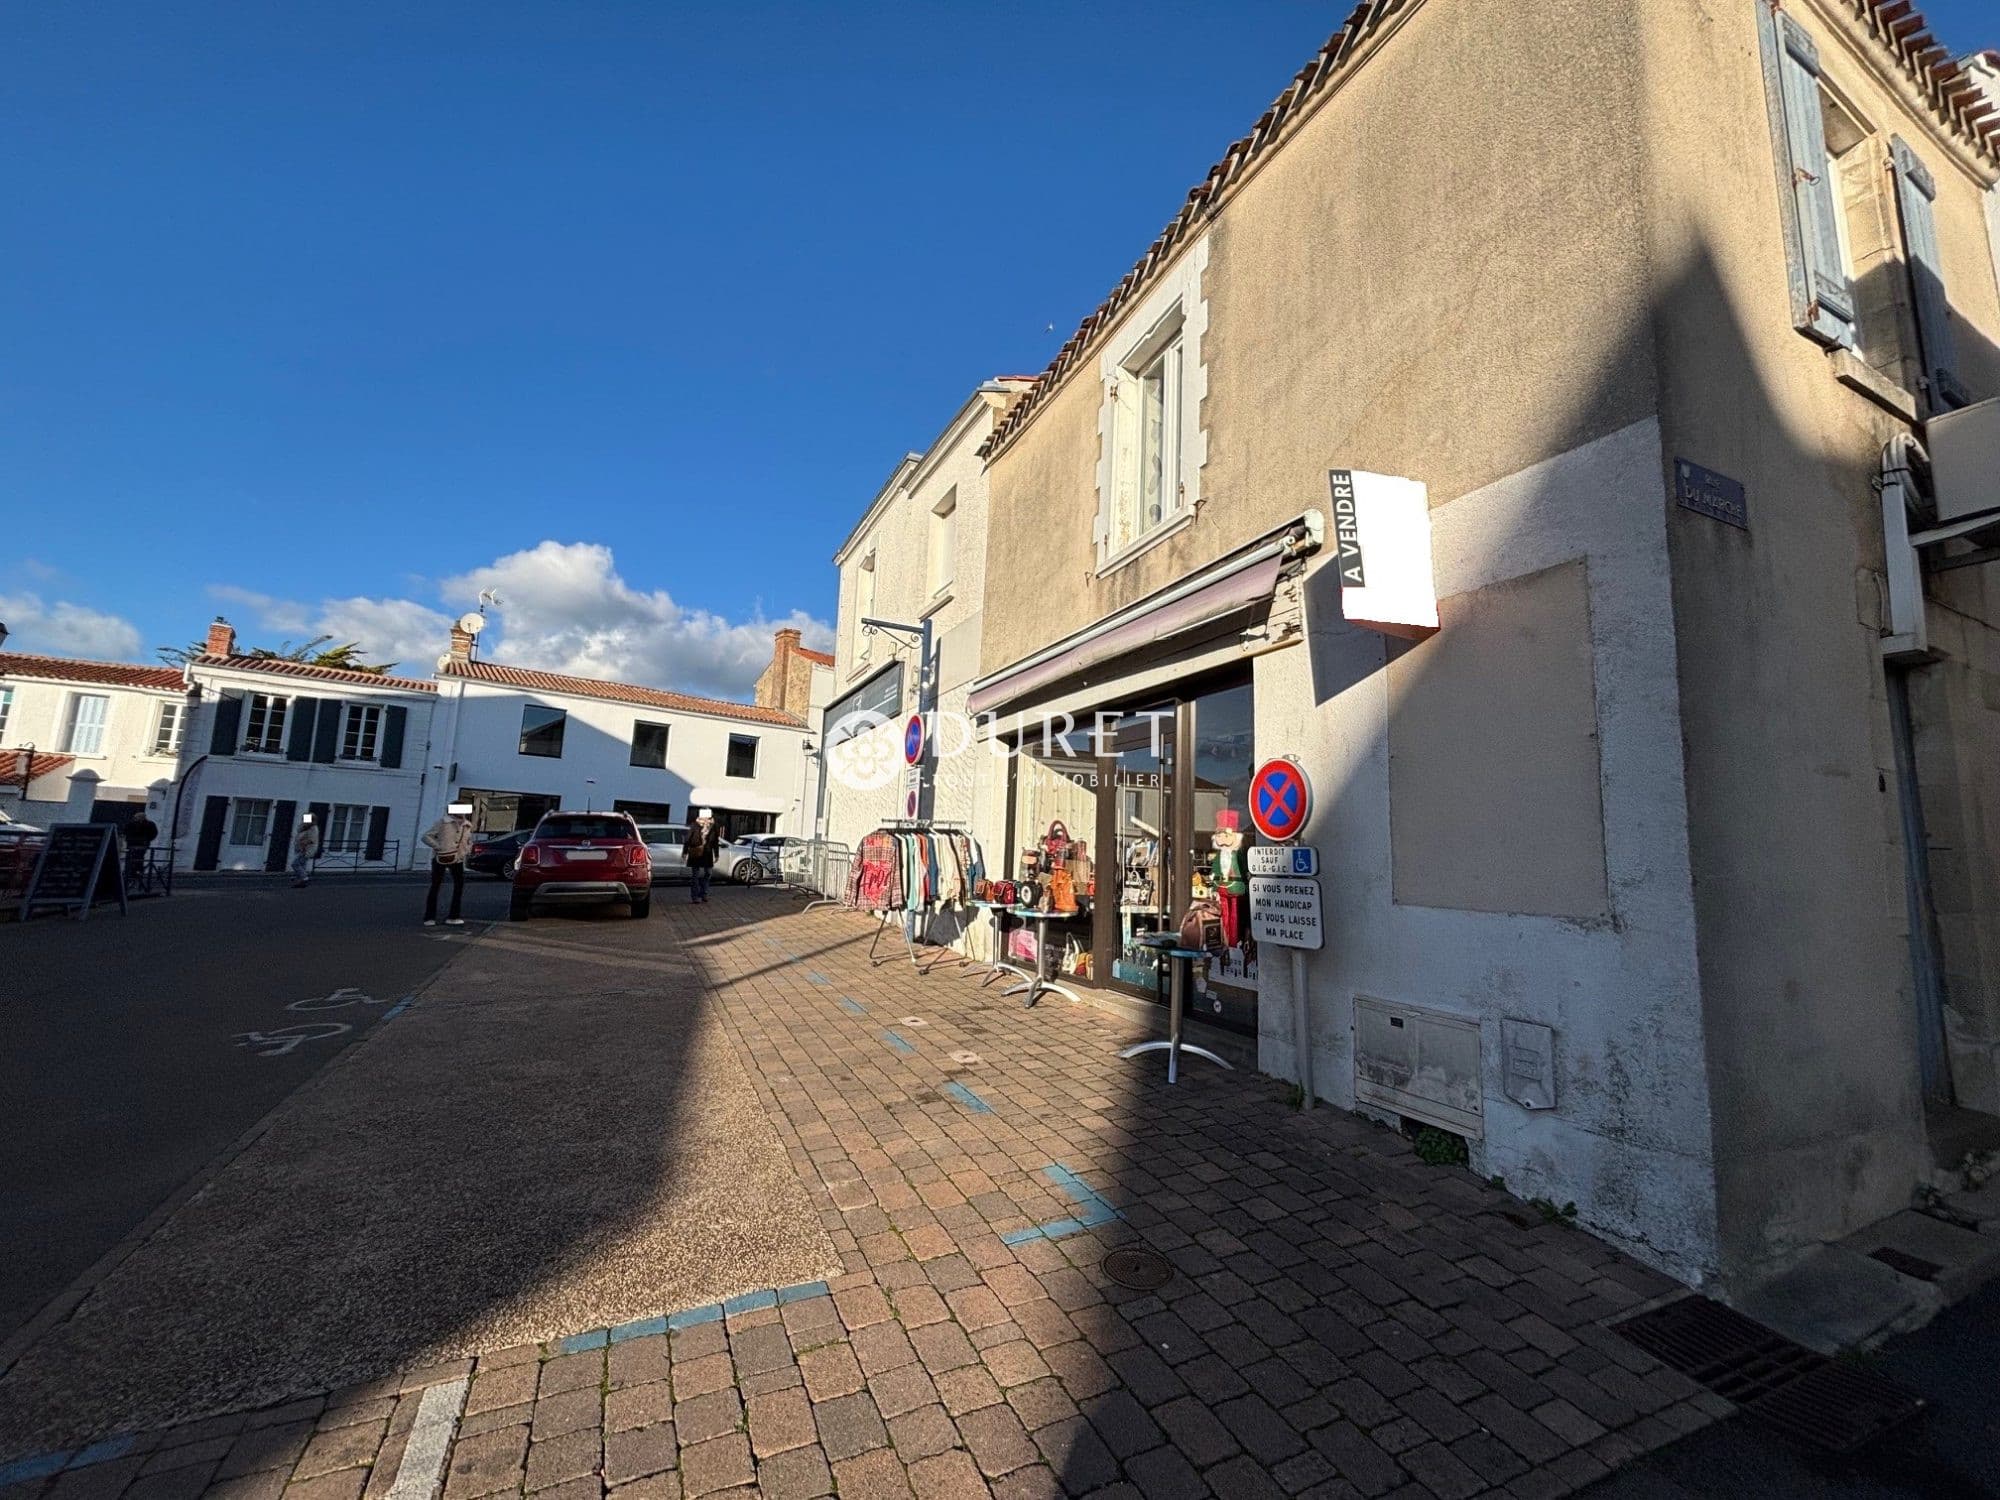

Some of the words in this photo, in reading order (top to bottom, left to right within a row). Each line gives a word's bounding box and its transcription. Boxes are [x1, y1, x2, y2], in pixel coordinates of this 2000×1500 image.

[1685, 486, 1699, 501] DU
[1333, 474, 1359, 558] VENDRE
[1344, 566, 1362, 582] A
[1252, 884, 1259, 892] SI
[1263, 884, 1281, 893] VOUS
[1285, 886, 1314, 895] PRENEZ
[1256, 898, 1271, 907] MON
[1275, 900, 1312, 910] HANDICAP
[1254, 912, 1262, 920] JE
[1265, 913, 1284, 923] VOUS
[1289, 916, 1316, 926] LAISSE
[1266, 928, 1276, 936] MA
[1280, 929, 1304, 940] PLACE
